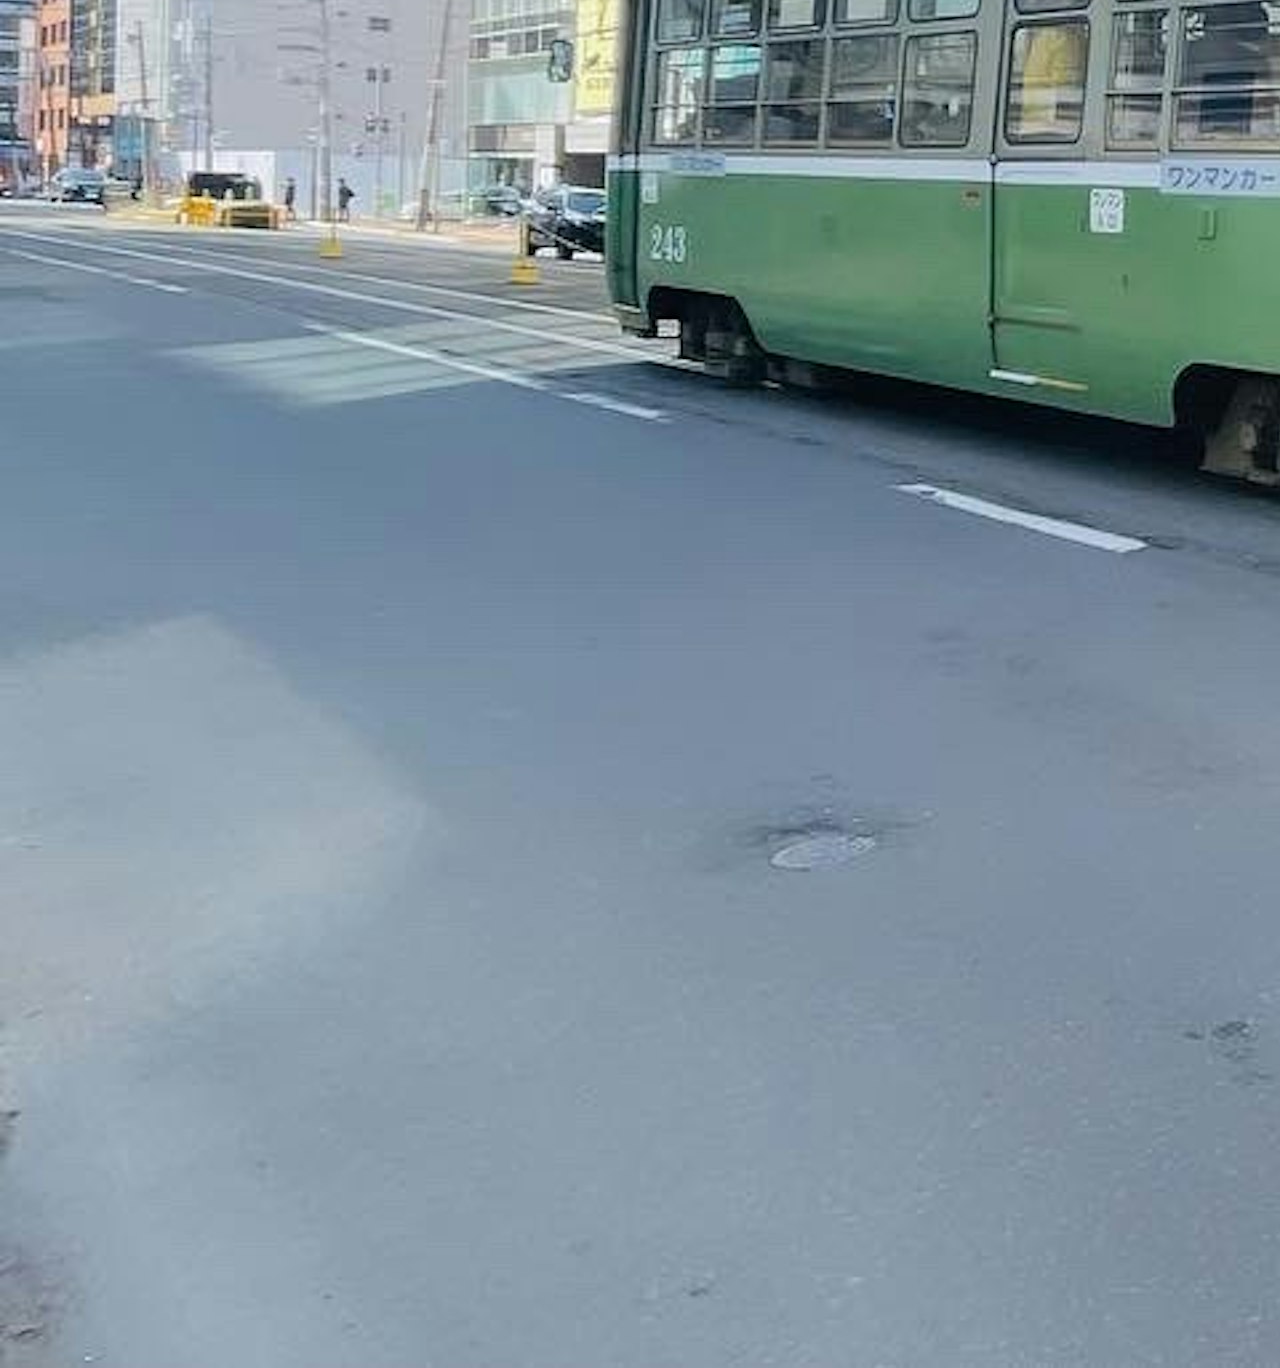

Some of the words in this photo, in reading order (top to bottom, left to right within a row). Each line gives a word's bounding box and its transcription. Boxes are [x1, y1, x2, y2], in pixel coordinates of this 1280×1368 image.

[1168, 167, 1276, 191] ワンマンカー
[650, 223, 687, 263] 243
